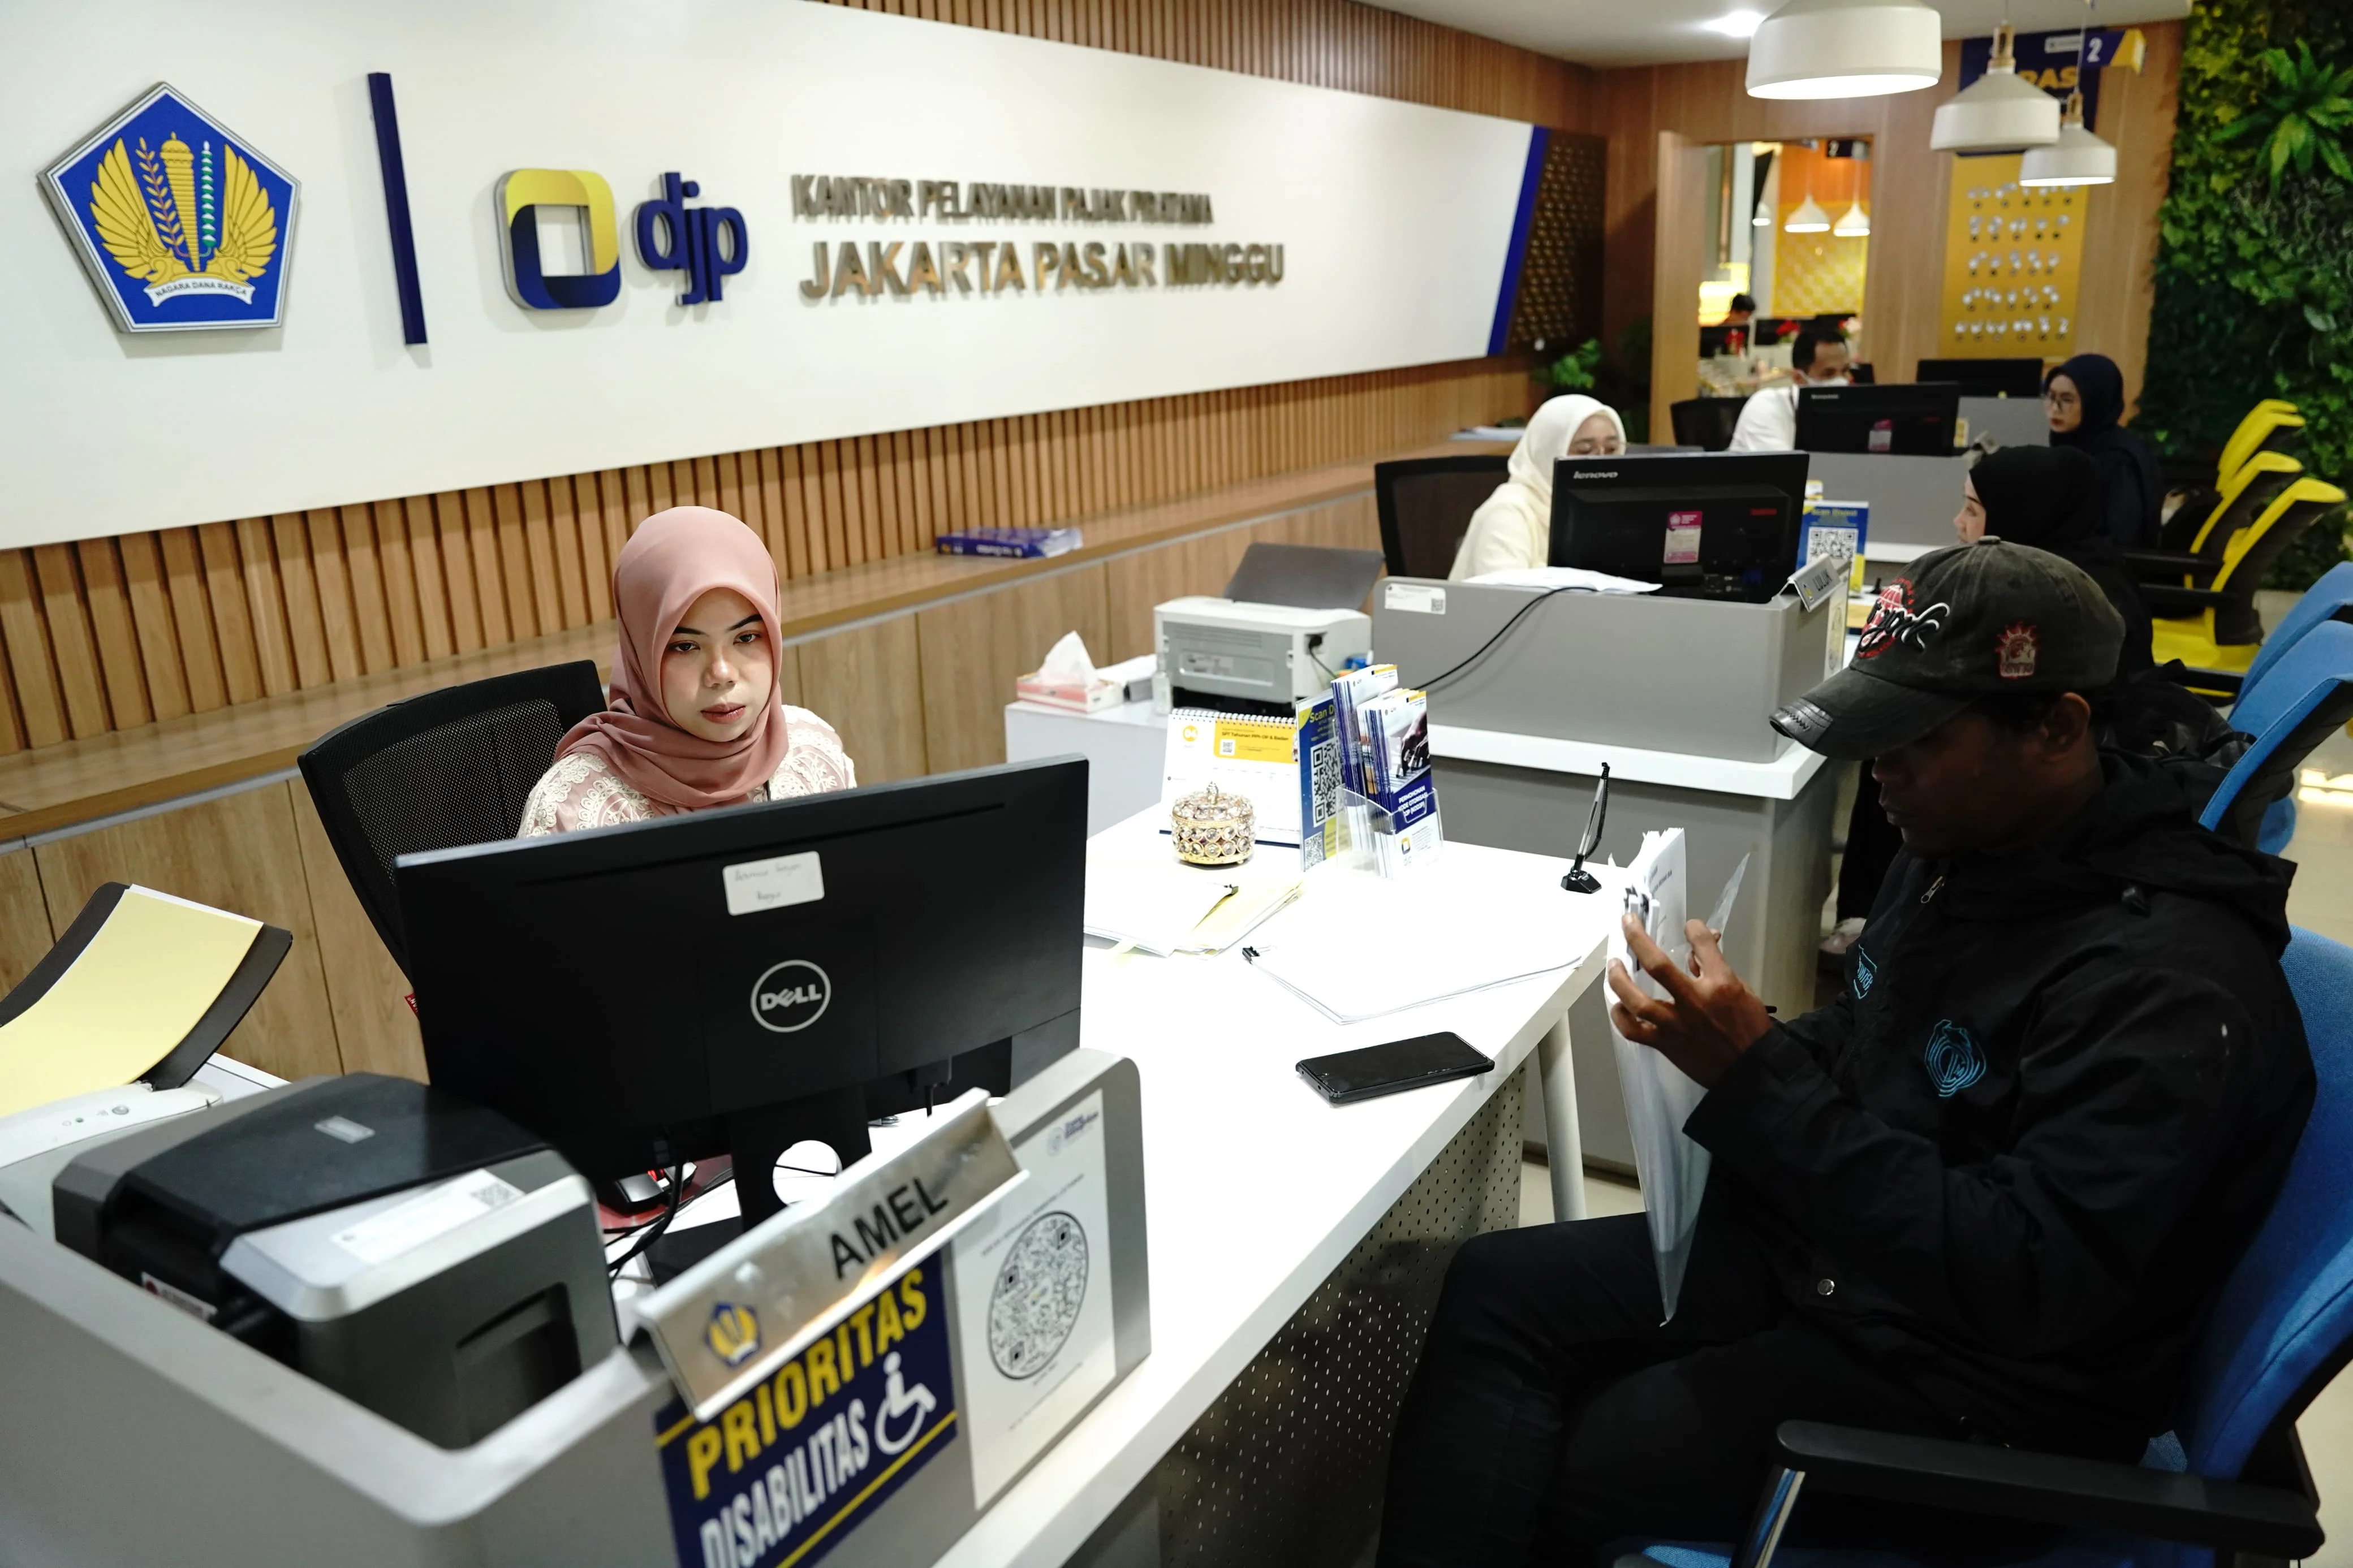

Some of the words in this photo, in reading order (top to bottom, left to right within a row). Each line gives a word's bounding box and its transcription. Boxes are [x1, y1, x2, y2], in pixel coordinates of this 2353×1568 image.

[791, 174, 914, 219] KANTOR
[917, 179, 1057, 221] PELAYANAN
[1060, 187, 1126, 223] PAJAK
[798, 241, 1026, 297] JAKARTA
[1031, 242, 1157, 290] PASAR
[1162, 243, 1286, 287] MINGGU
[1309, 709, 1328, 723] Scan
[760, 984, 822, 1011] DELL
[828, 1176, 950, 1280] AMEL
[685, 1268, 928, 1502] PRIORITAS
[699, 1399, 870, 1568] DISABILITAS
